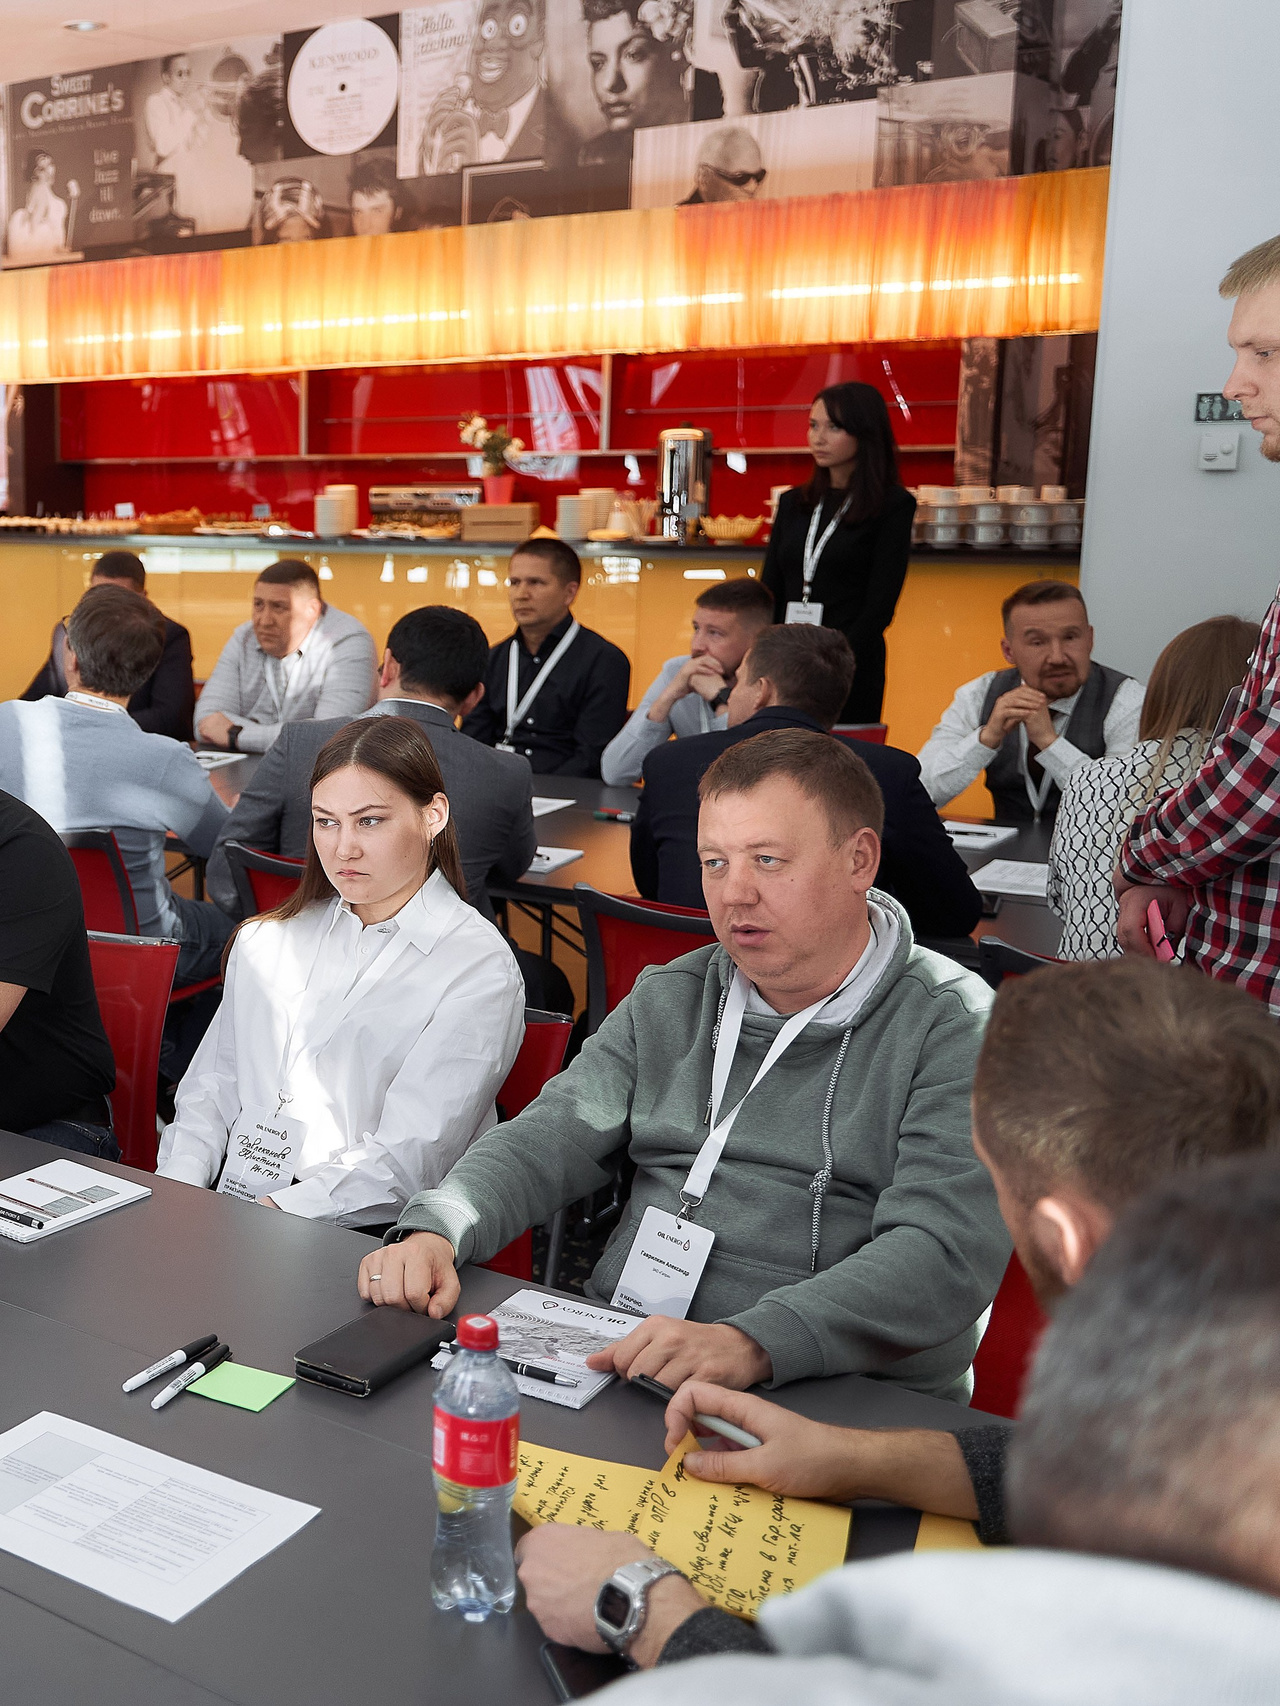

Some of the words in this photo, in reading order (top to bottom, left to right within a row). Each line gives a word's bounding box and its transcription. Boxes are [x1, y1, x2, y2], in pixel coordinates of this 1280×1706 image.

[665, 1234, 683, 1246] ENERGY
[561, 1306, 603, 1322] ENERGY
[607, 1317, 627, 1325] OIL
